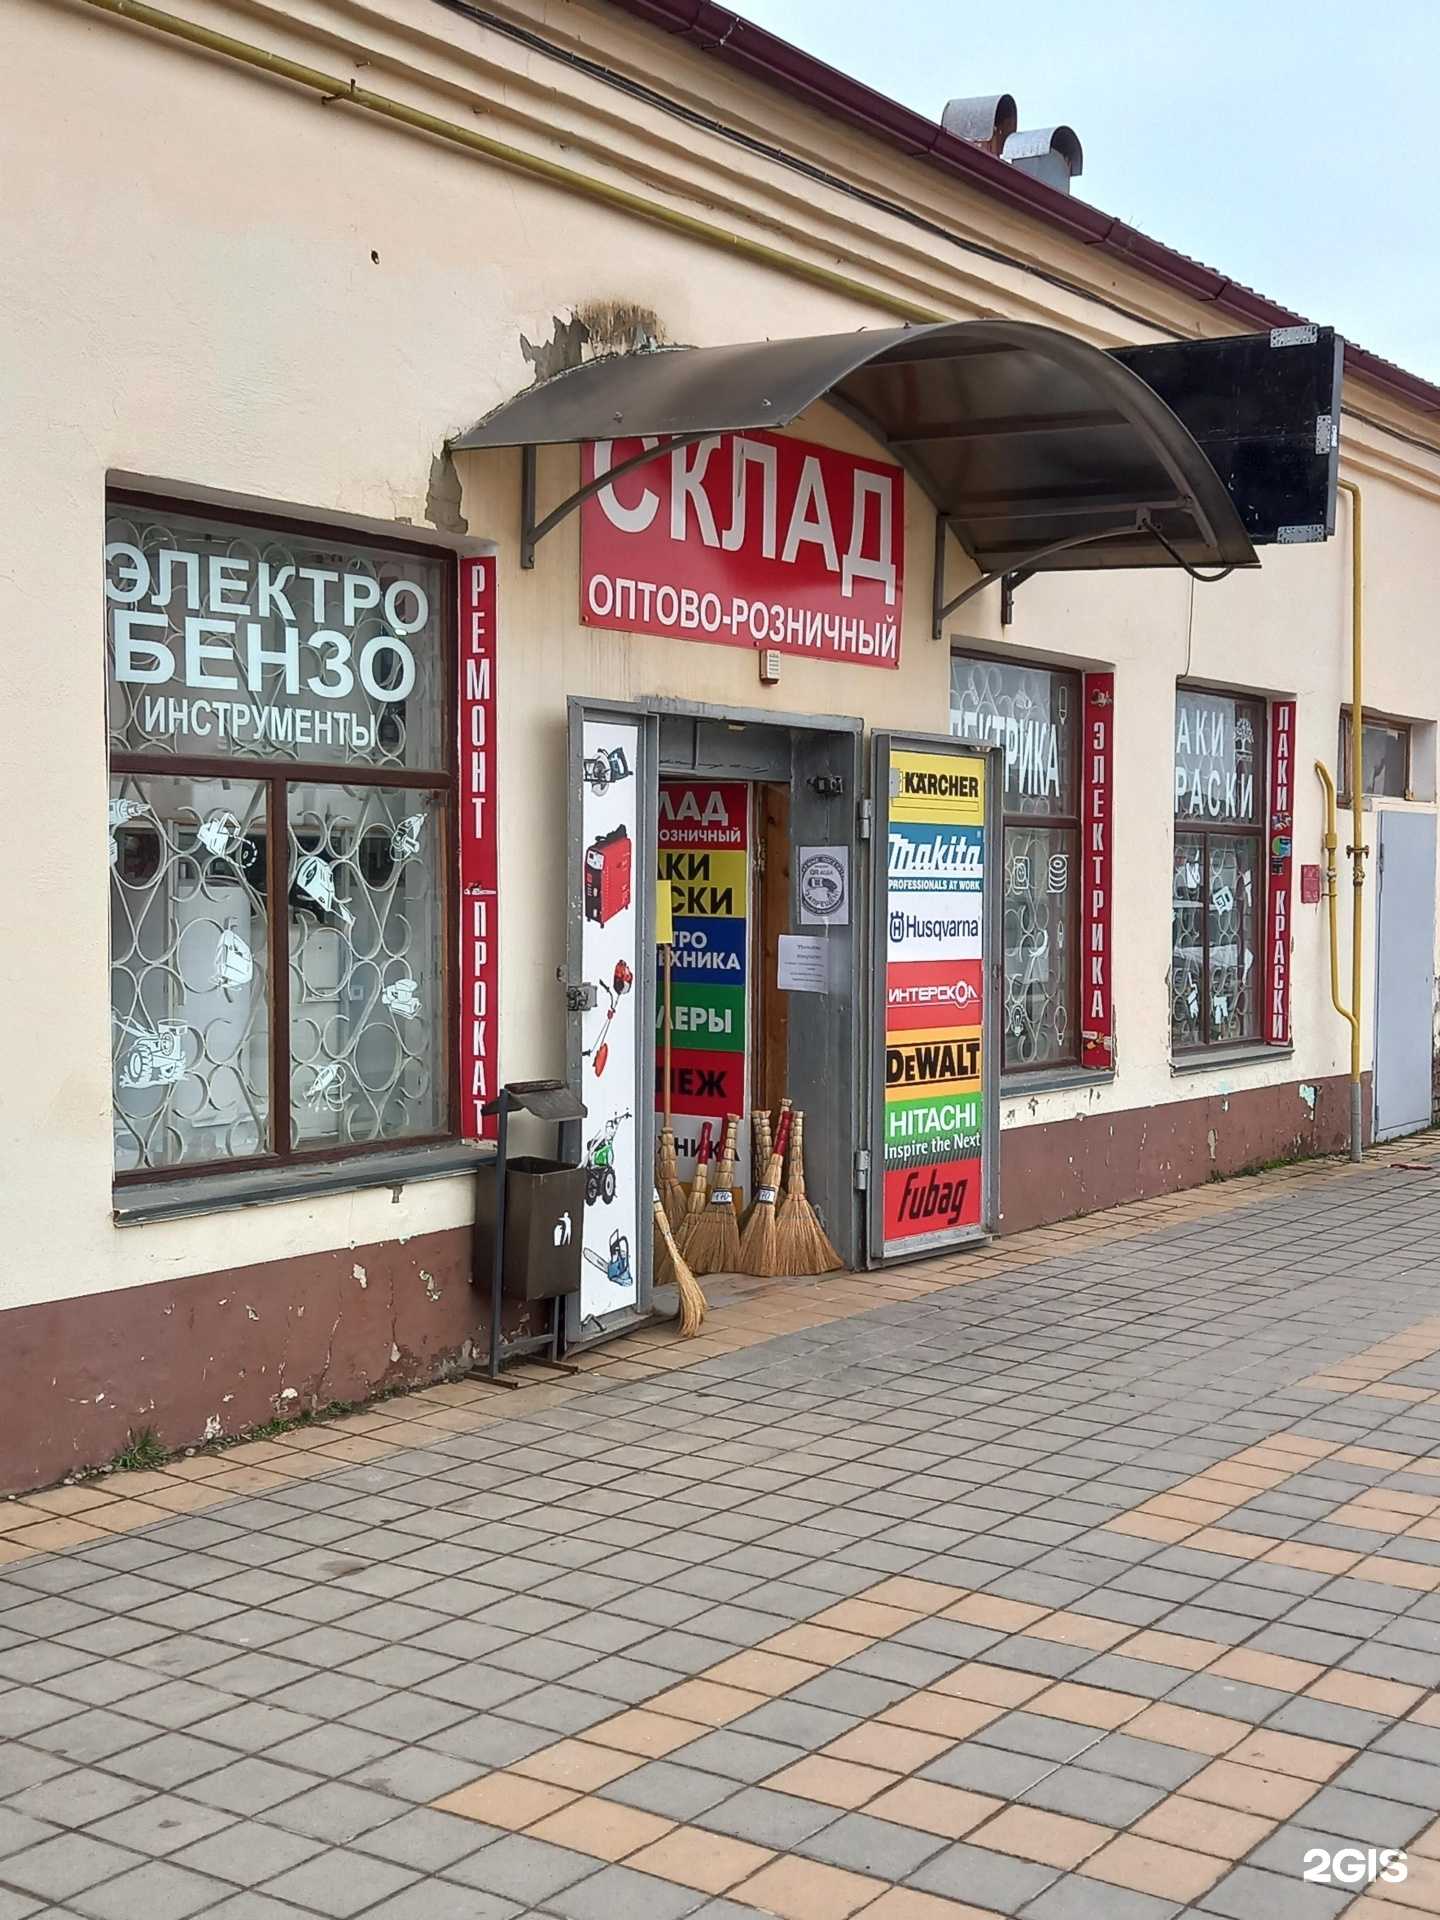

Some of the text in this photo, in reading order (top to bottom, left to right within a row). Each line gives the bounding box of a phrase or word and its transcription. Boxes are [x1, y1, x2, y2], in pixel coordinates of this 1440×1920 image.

[594, 435, 896, 606] СКЛАД
[106, 542, 429, 634] ЭЛЕКТРО
[588, 574, 898, 660] ОПТОВО-РОЗНИЧНЫЙ
[113, 608, 417, 703] БЕНЗО
[144, 695, 377, 748] ИНСТРУМЕНТЫ
[466, 564, 490, 841] РЕМОНТ
[904, 771, 979, 798] KÄRCHER
[949, 708, 1060, 798] ТРИКА
[1275, 706, 1290, 812] ЛАКИ
[658, 853, 711, 882] КИ
[888, 878, 981, 891] PROFESSIONALS AT WORK
[1090, 721, 1105, 1019] ЭЛЕКТРИКА
[905, 915, 979, 942] Husqvarna
[1270, 889, 1288, 1041] КРАСКИ
[472, 901, 489, 1137] ПРОКАТ
[888, 981, 978, 1004] ИНТЕРСКОЛ
[884, 1130, 982, 1162] Inspire the Next
[889, 1102, 977, 1138] HITACHI
